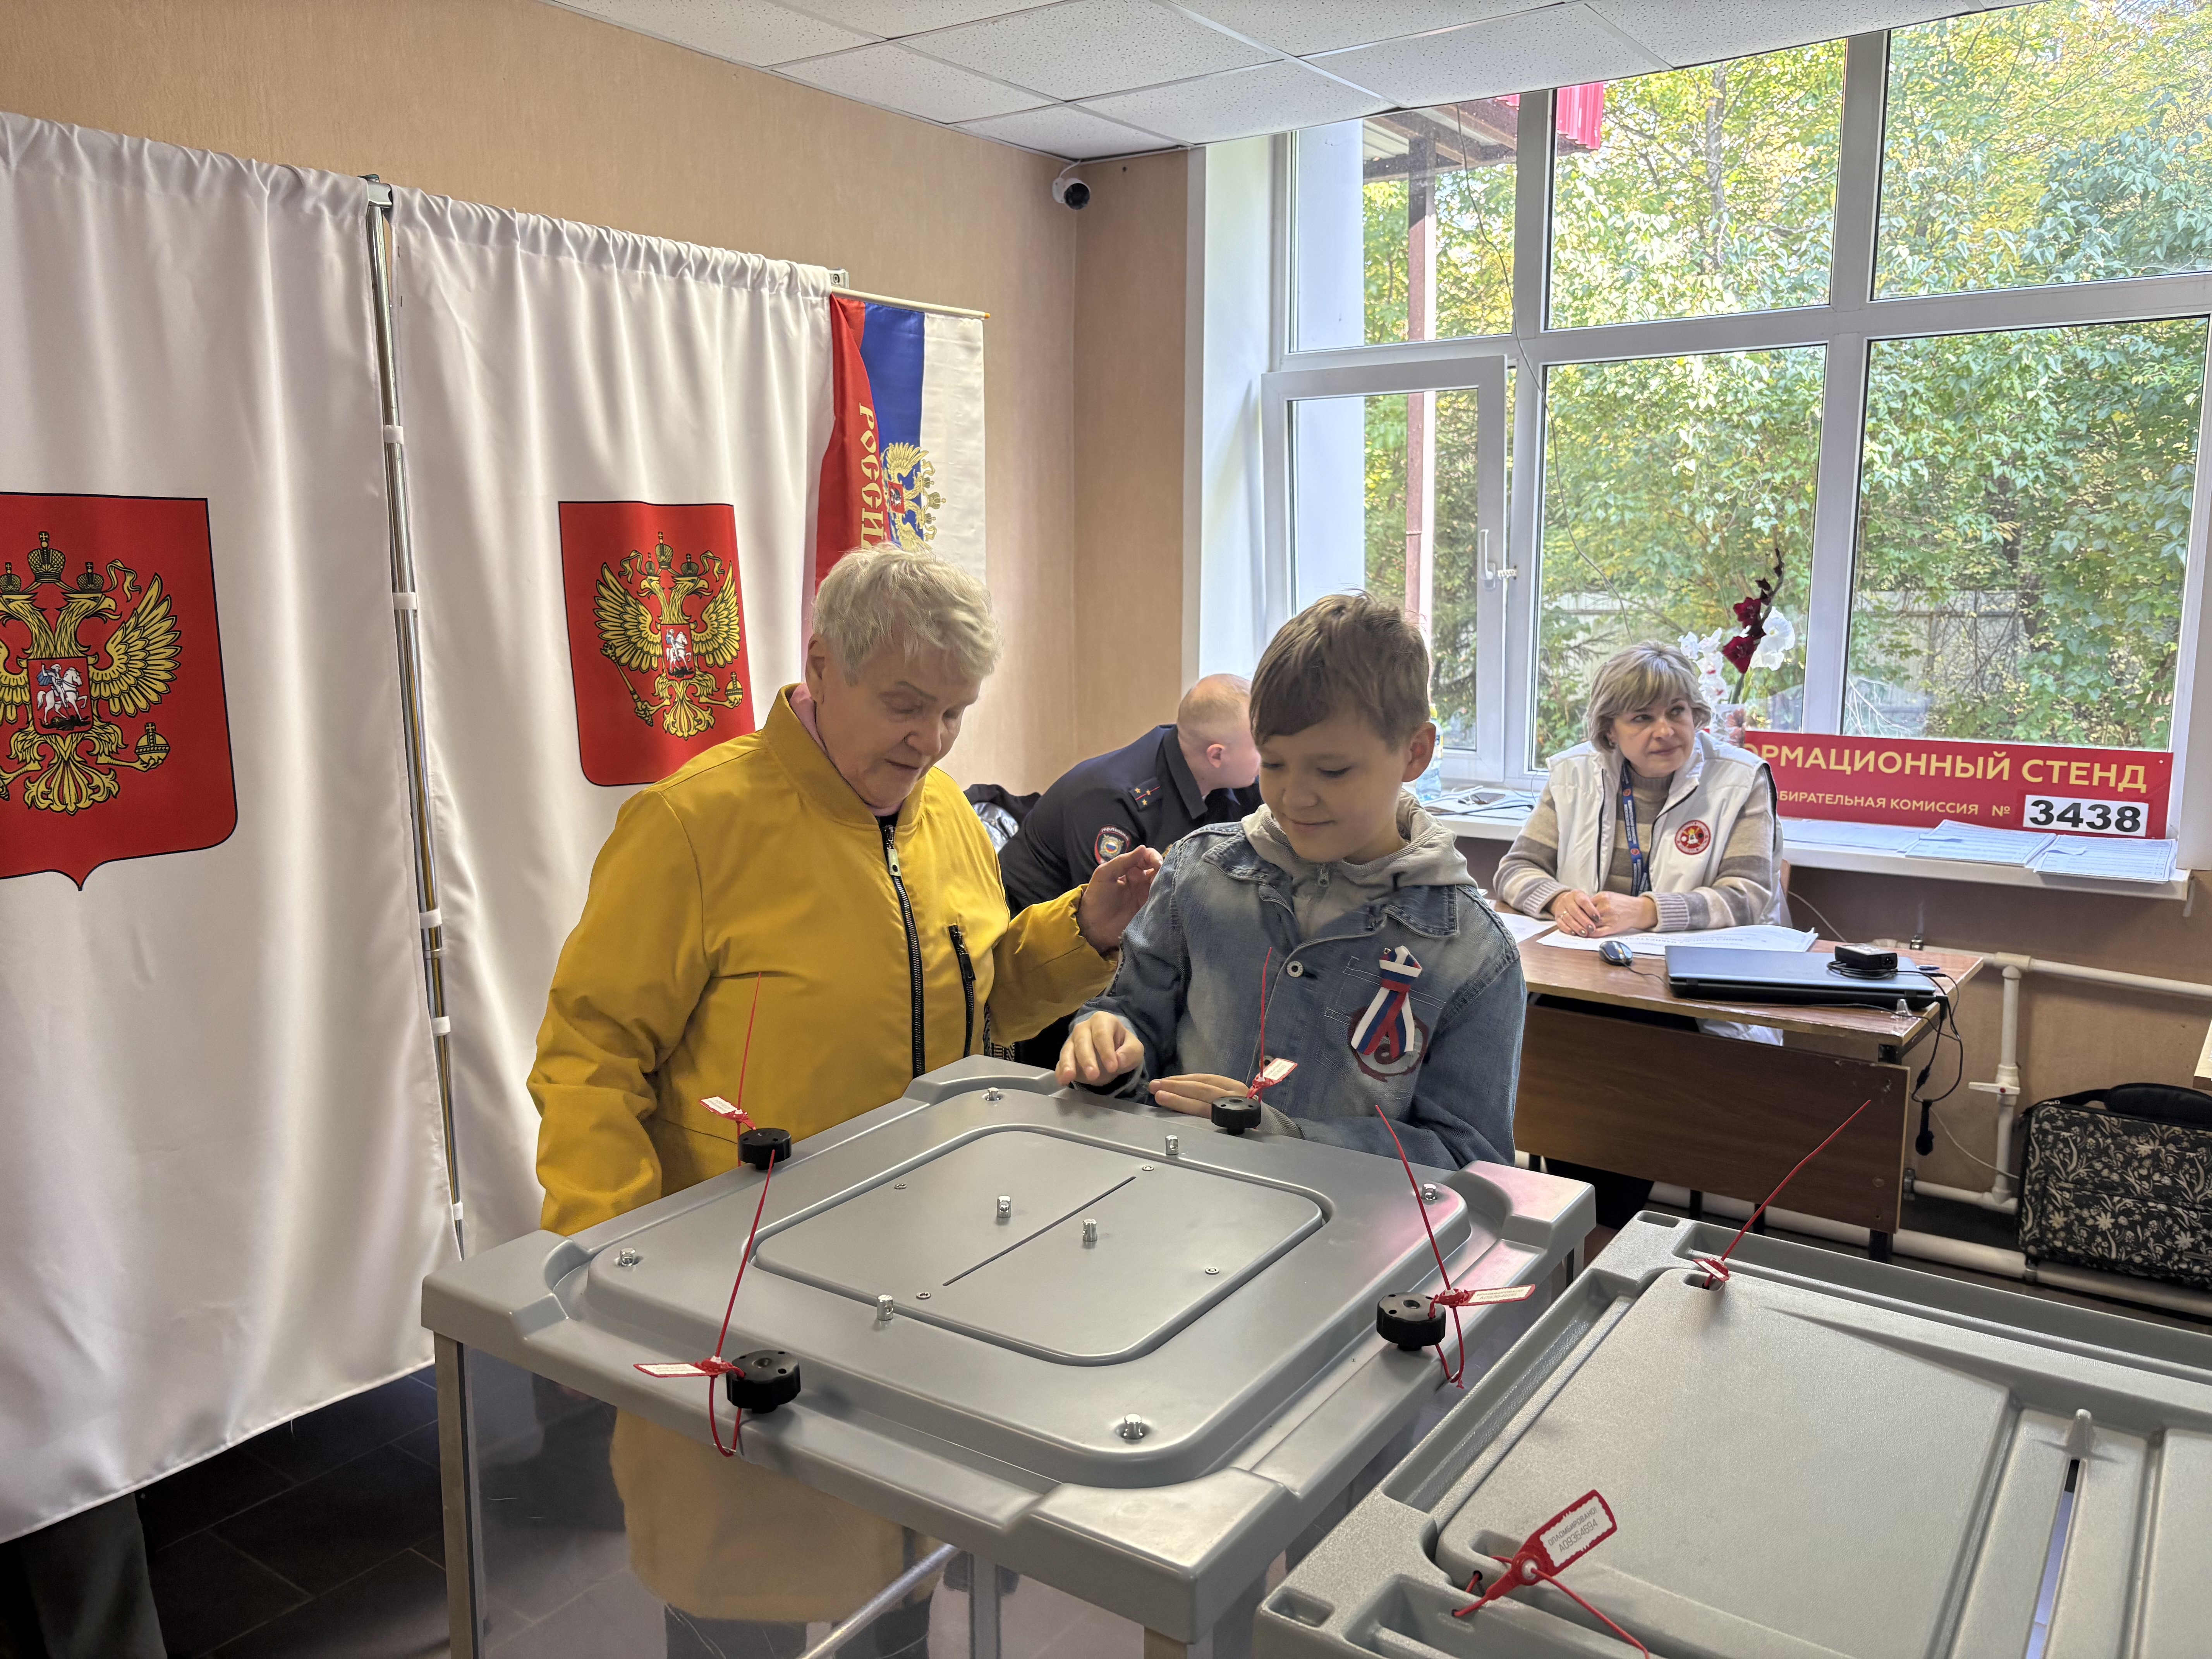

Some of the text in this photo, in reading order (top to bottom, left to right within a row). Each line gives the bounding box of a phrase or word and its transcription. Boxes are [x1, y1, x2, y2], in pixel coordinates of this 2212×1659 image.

[2022, 759, 2147, 793] СТЕНД
[1891, 799, 1978, 815] КОМИССИЯ
[1992, 805, 2011, 817] №
[2029, 800, 2141, 832] 3438
